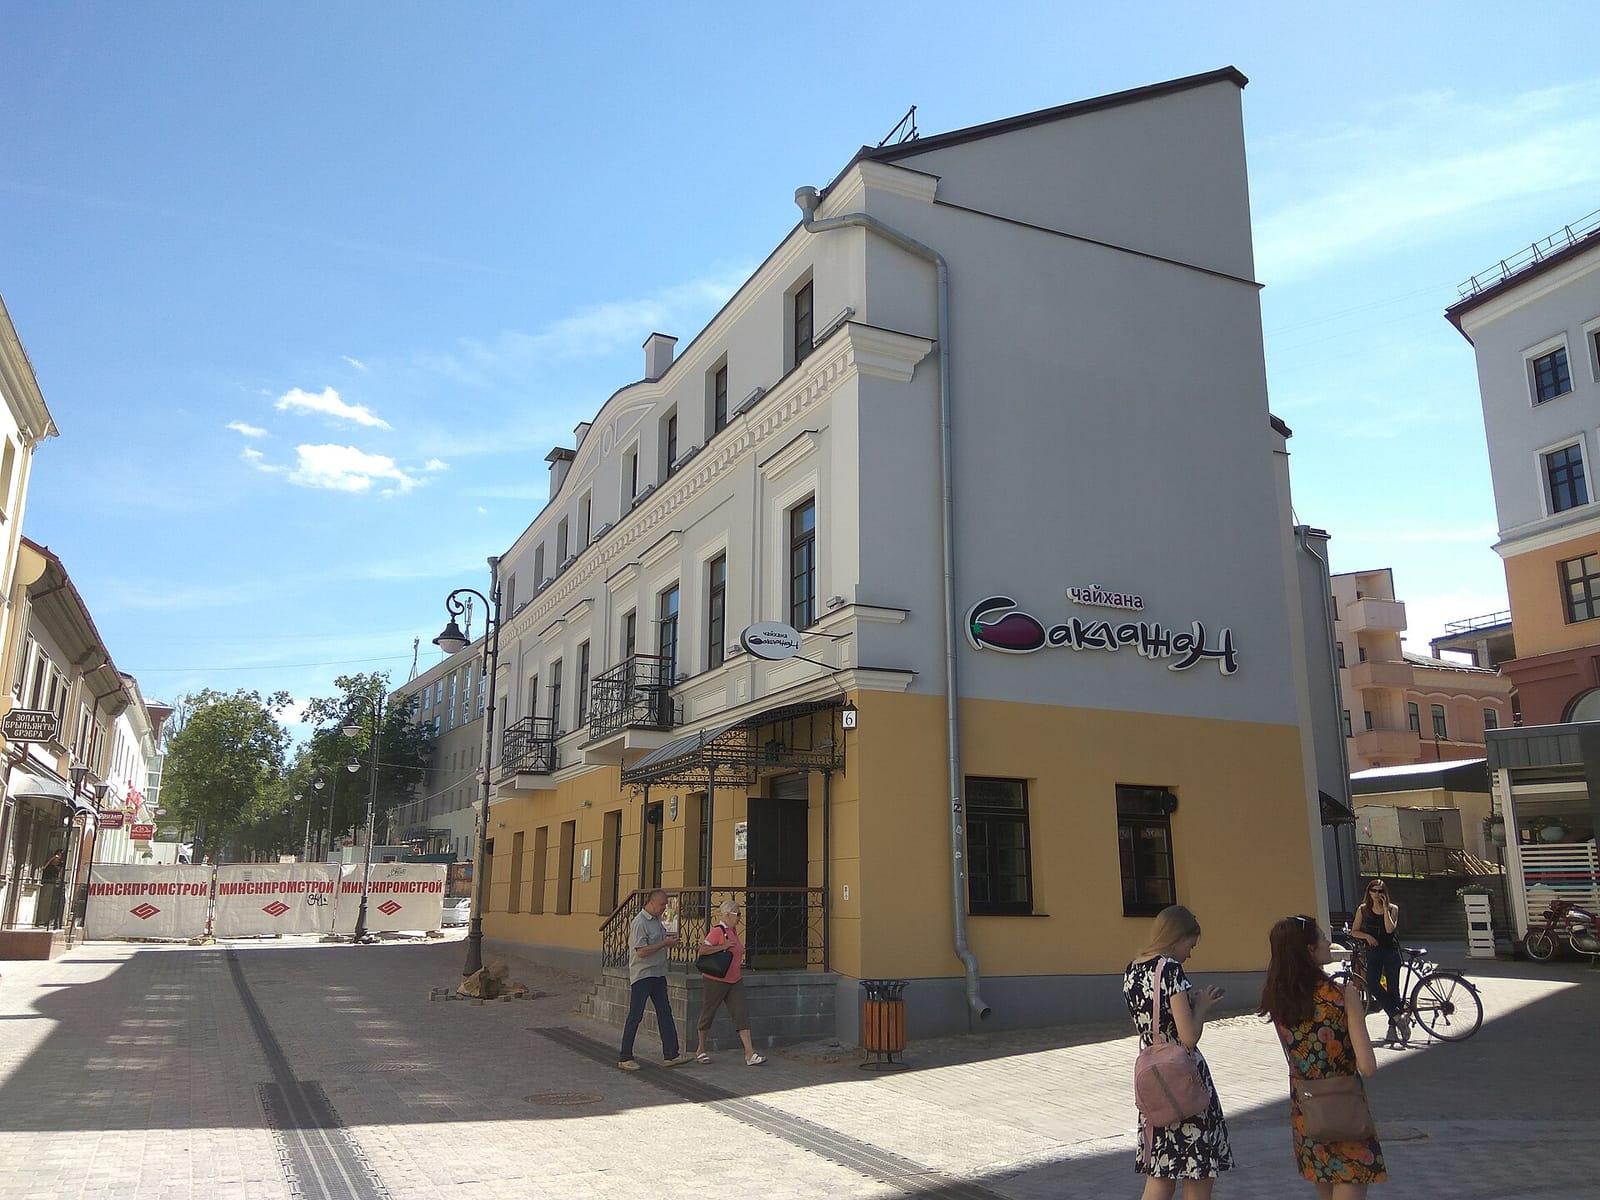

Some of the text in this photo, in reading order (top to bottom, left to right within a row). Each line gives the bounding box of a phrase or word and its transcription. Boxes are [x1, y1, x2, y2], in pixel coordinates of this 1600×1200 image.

[1068, 584, 1144, 610] чайхана
[763, 630, 788, 639] чайхана
[15, 713, 47, 723] ЗОЛАТА
[845, 712, 853, 726] 6
[5, 720, 55, 731] БРЫЛЬЯНТЫ
[14, 729, 43, 738] СРЭБРА
[88, 881, 208, 896] МИНСКПРОМСТРОЙ
[219, 880, 335, 895] МИНСКПРОМСТРОЙ
